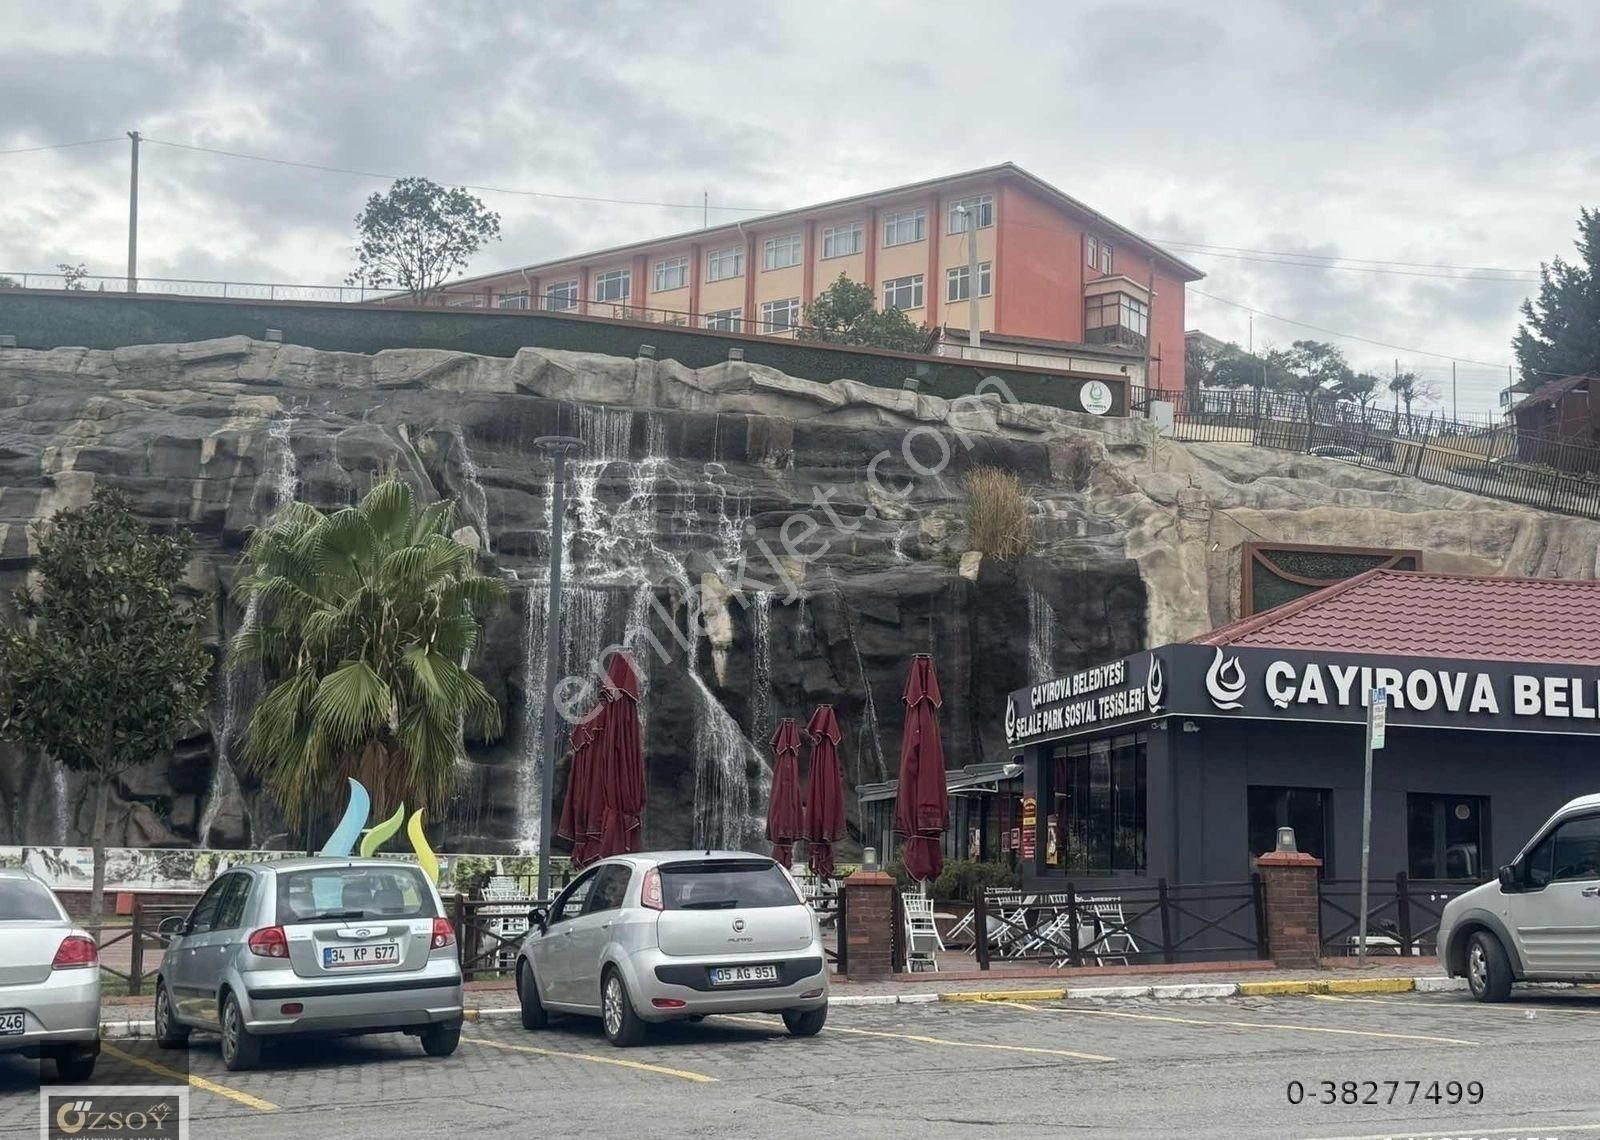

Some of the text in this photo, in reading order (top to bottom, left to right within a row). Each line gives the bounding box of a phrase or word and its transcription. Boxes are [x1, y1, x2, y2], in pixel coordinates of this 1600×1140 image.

[1031, 660, 1124, 710] ÇAYIROVA BELEDİYESİ
[1264, 660, 1600, 719] ÇAYIROVA BEL
[1016, 686, 1145, 740] ŞELALE PARK SOSYAL TESİSLERİ
[332, 946, 395, 962] 34 KP 677
[717, 966, 775, 981] 05 AG 951
[0, 1015, 22, 1029] 246
